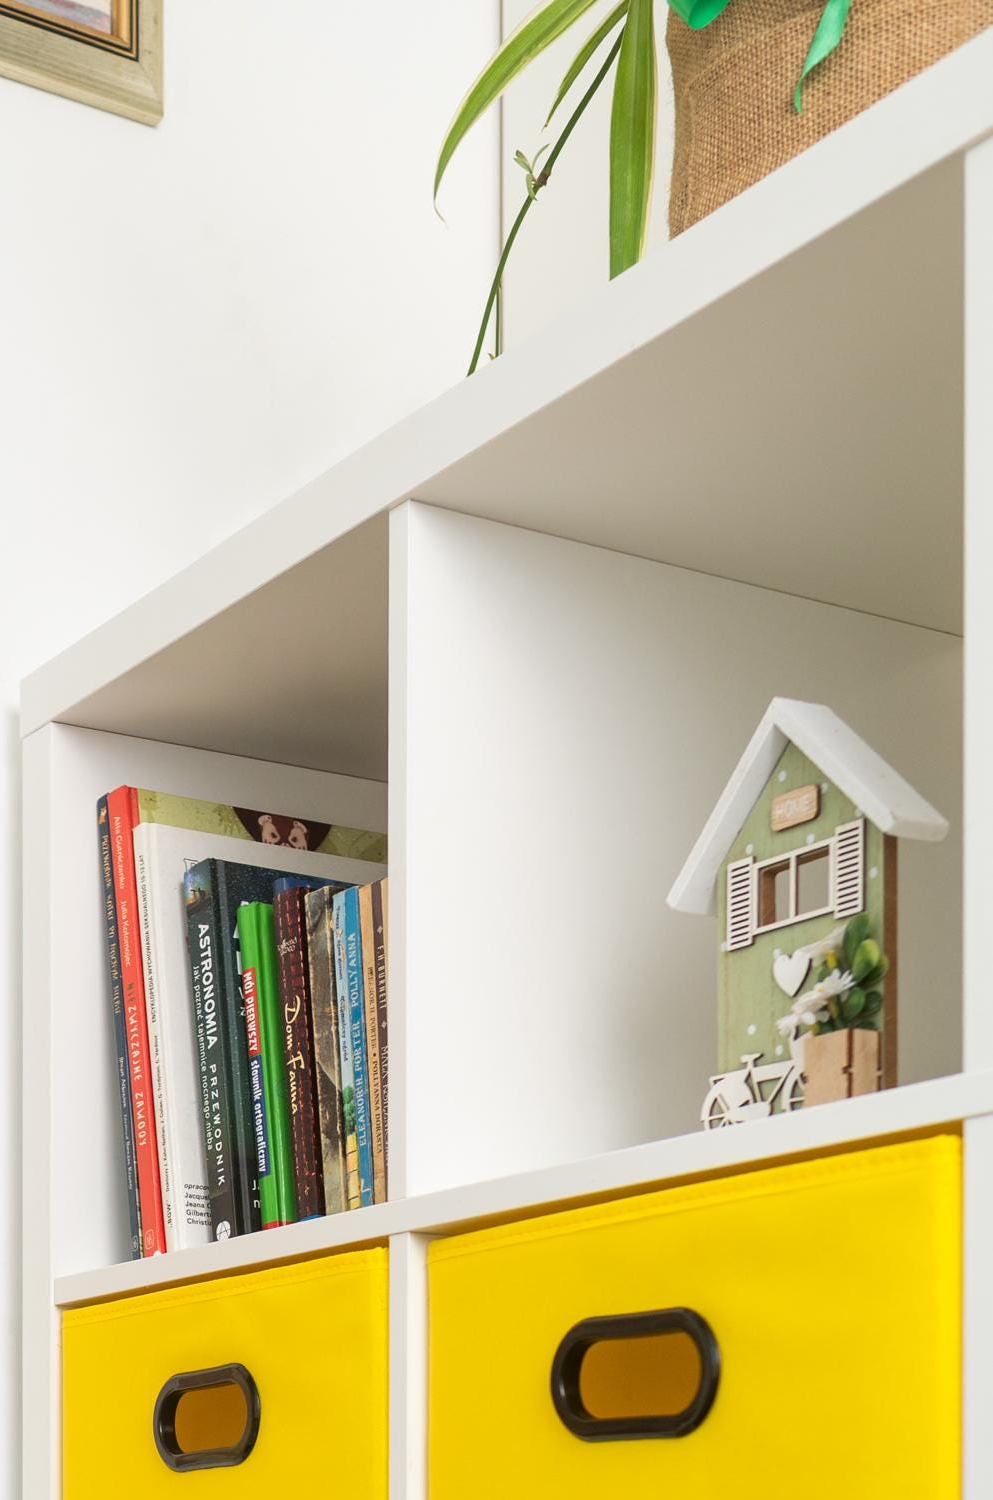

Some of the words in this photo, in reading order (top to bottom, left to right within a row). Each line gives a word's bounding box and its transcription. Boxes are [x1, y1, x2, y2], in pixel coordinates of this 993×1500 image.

[243, 971, 254, 995] MÓJ
[348, 932, 358, 1007] POLLYANNA
[194, 984, 204, 1020] poznać
[246, 996, 258, 1052] PIERWSZY
[285, 995, 301, 1050] Dom
[197, 1023, 207, 1072] tajemnice
[197, 924, 218, 1050] ASTRONOMIA
[209, 1063, 226, 1187] PRZEWODNIK
[352, 1021, 361, 1072] PORTER
[202, 1075, 211, 1119] nocnego
[250, 1060, 263, 1102] słownik
[287, 1051, 305, 1114] Fauna
[373, 1060, 381, 1111] POLLYANNA
[134, 1092, 147, 1146] ZAWODY
[254, 1103, 267, 1173] ortograficzny
[356, 1086, 367, 1147] ELEANOR
[375, 1113, 383, 1153] DORASTA
[184, 1183, 209, 1191] opraco
[187, 1217, 212, 1226] Christi
